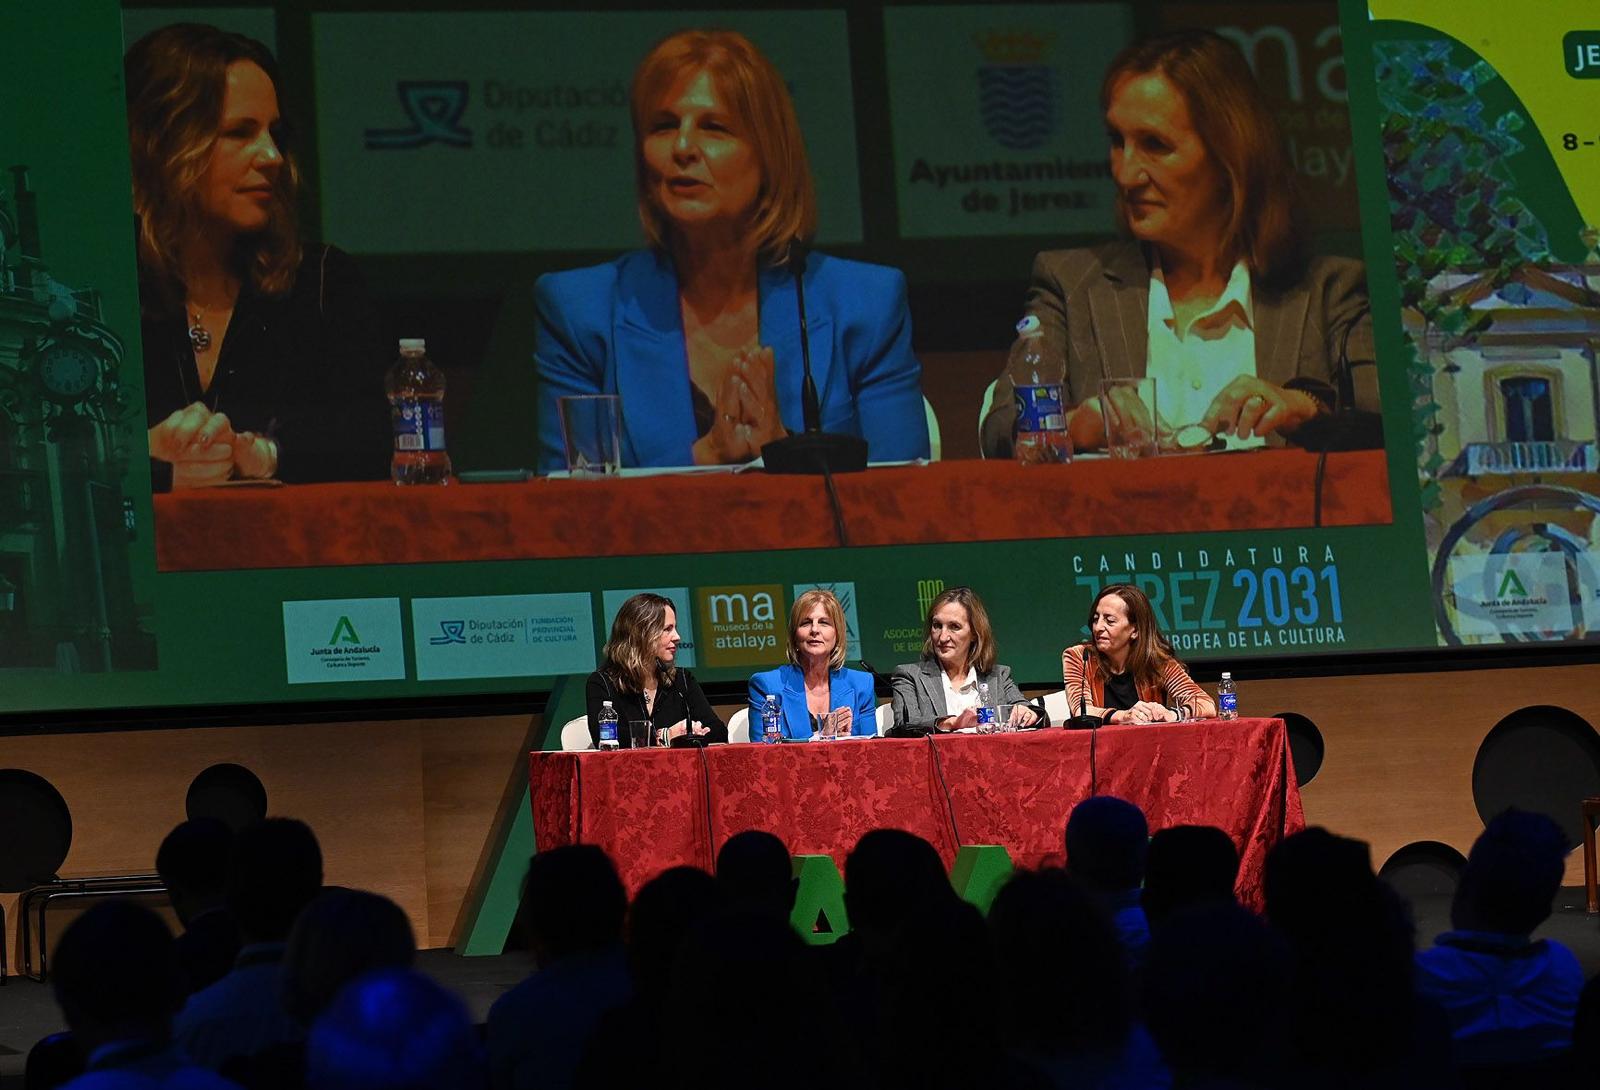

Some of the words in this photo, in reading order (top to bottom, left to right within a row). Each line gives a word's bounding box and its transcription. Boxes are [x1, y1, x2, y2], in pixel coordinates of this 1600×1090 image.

[484, 79, 625, 110] Diputació
[486, 121, 523, 146] de
[536, 118, 618, 146] Cádiz
[1562, 133, 1578, 150] 8
[909, 157, 1108, 187] Ayuntamien
[961, 189, 999, 212] de
[1008, 188, 1089, 217] Jerez
[1073, 544, 1335, 573] CANDIDATURA
[1232, 563, 1343, 628] 2031
[709, 592, 775, 623] ma
[469, 618, 524, 632] Diputación
[713, 622, 750, 631] museos
[752, 621, 763, 630] de
[765, 621, 774, 630] la
[470, 634, 483, 644] de
[487, 632, 515, 644] Cádiz
[533, 635, 543, 643] DE
[716, 633, 776, 650] atalaya
[1228, 631, 1247, 648] DE
[1253, 630, 1272, 646] LA
[1279, 626, 1345, 645] CULTURA
[310, 648, 332, 656] Junta
[333, 646, 343, 655] de
[344, 645, 381, 655] Andalucía
